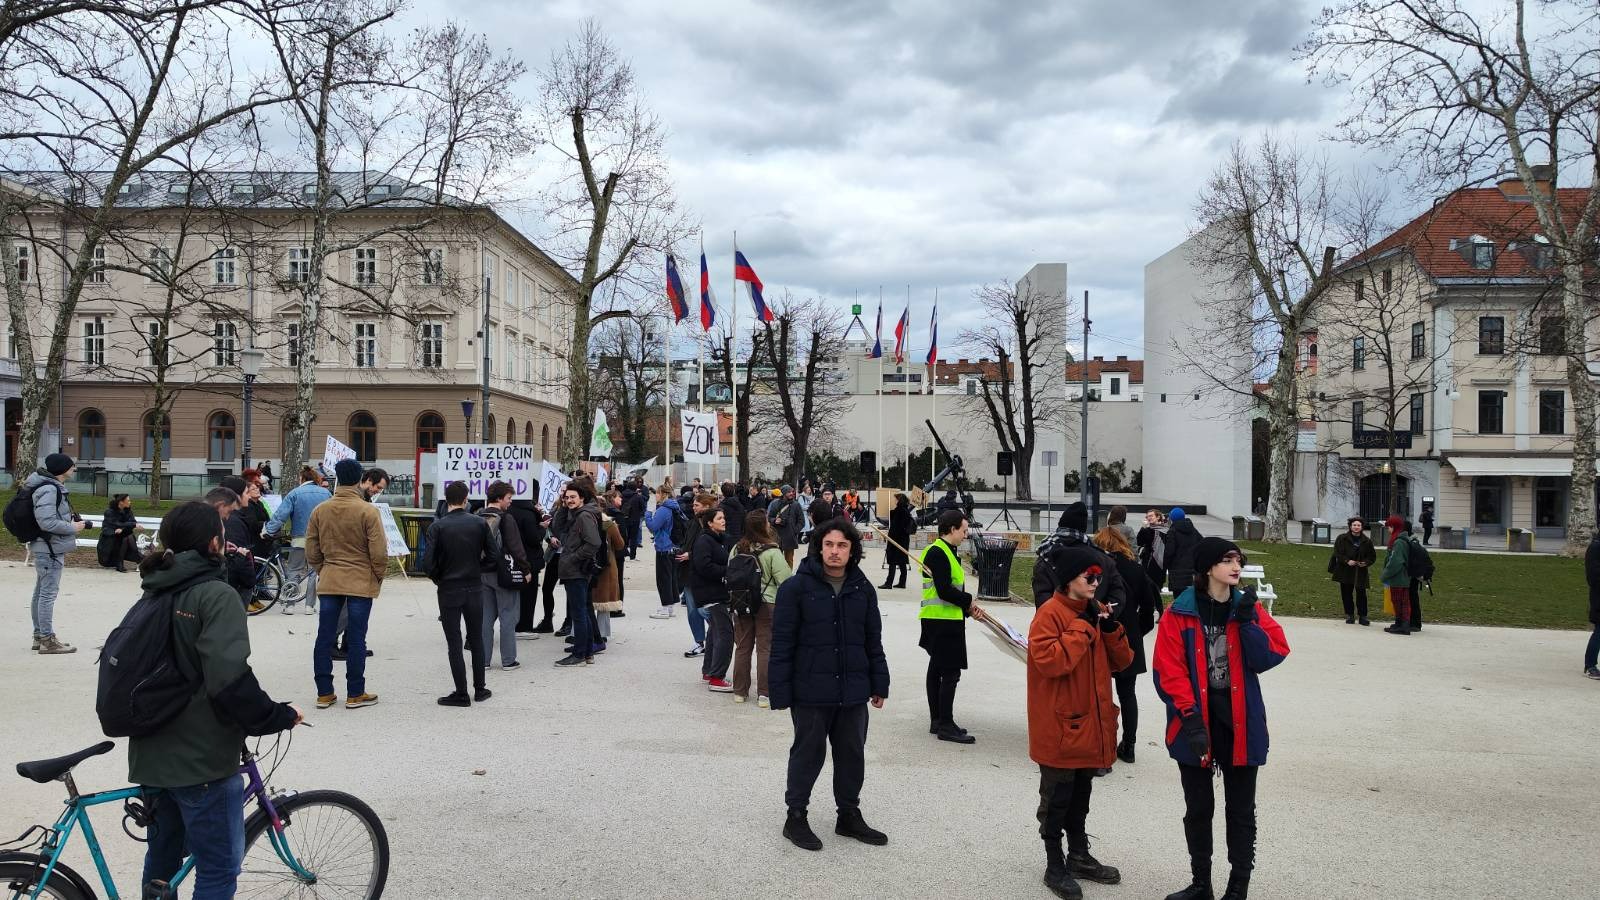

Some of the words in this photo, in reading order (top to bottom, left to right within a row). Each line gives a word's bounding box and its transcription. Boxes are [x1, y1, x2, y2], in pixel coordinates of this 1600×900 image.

[447, 447, 463, 459] TO
[468, 448, 481, 459] NI
[486, 446, 532, 460] ZLOČIN
[446, 461, 459, 470] IZ
[465, 461, 529, 471] LJUBEZNI
[469, 471, 482, 479] TO
[489, 471, 502, 479] JE
